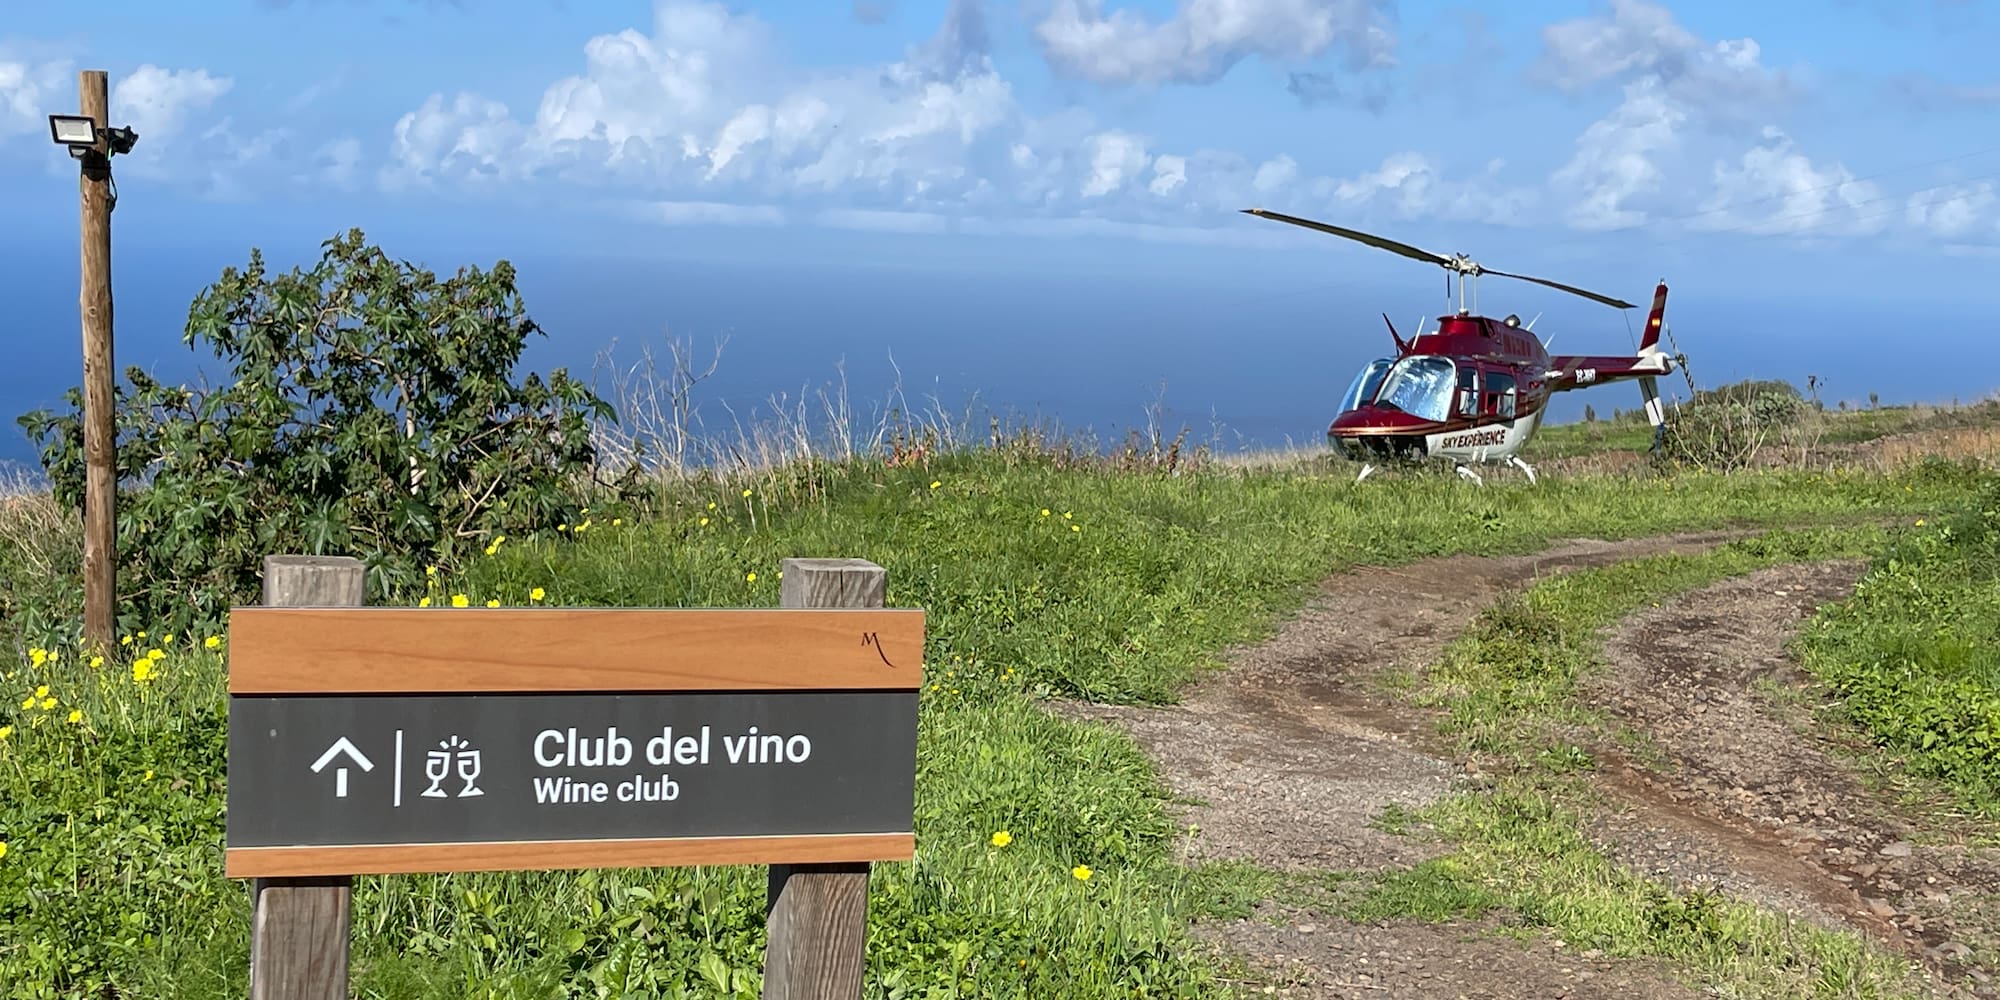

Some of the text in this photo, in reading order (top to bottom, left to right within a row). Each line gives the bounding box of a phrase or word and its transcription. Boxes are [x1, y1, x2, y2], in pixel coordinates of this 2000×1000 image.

[533, 726, 811, 768] Club del vino
[533, 774, 680, 804] Wine club
